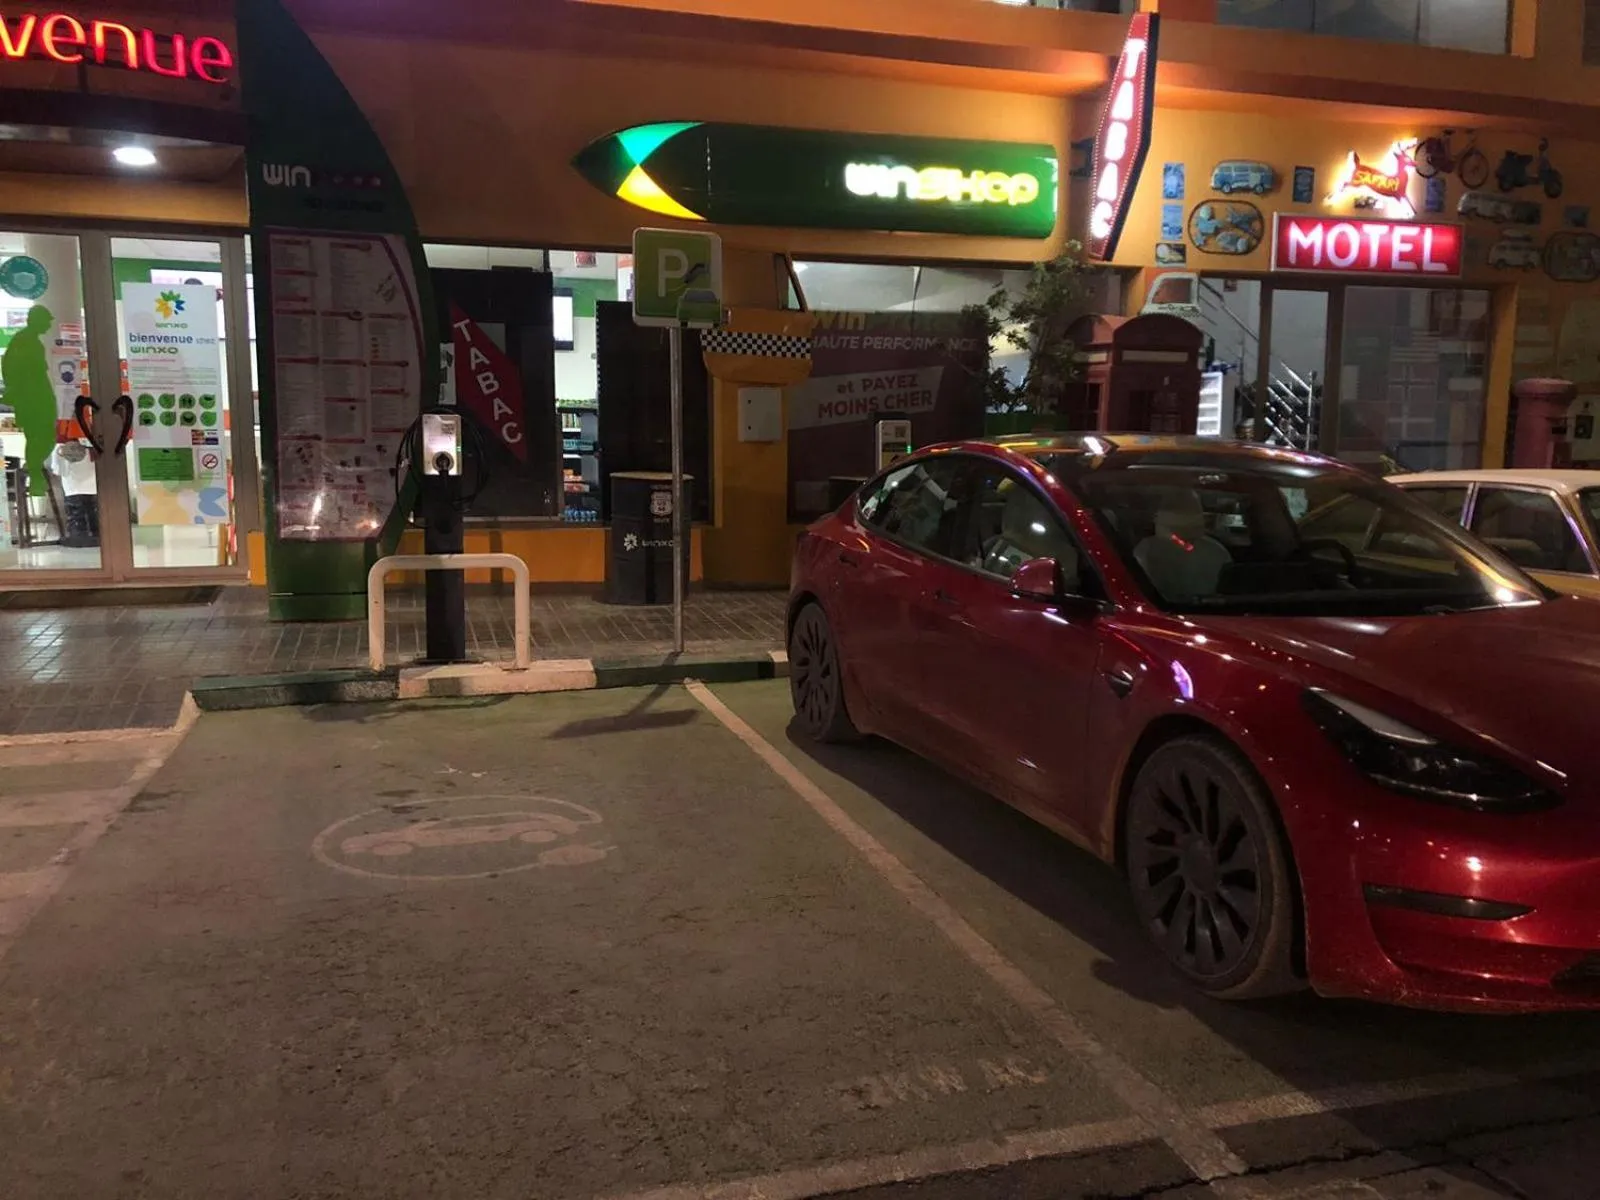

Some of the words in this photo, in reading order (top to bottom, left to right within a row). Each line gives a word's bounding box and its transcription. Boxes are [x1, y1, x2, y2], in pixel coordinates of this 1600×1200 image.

[1091, 37, 1147, 238] TABAC
[1352, 170, 1400, 191] SAFARI
[1288, 219, 1449, 272] MOTEL
[658, 248, 689, 297] P
[129, 332, 193, 344] bienvenue
[454, 319, 523, 444] TABAC
[837, 380, 854, 394] et
[862, 373, 919, 392] PAYEZ
[818, 397, 879, 419] MOINS
[884, 389, 933, 411] CHER
